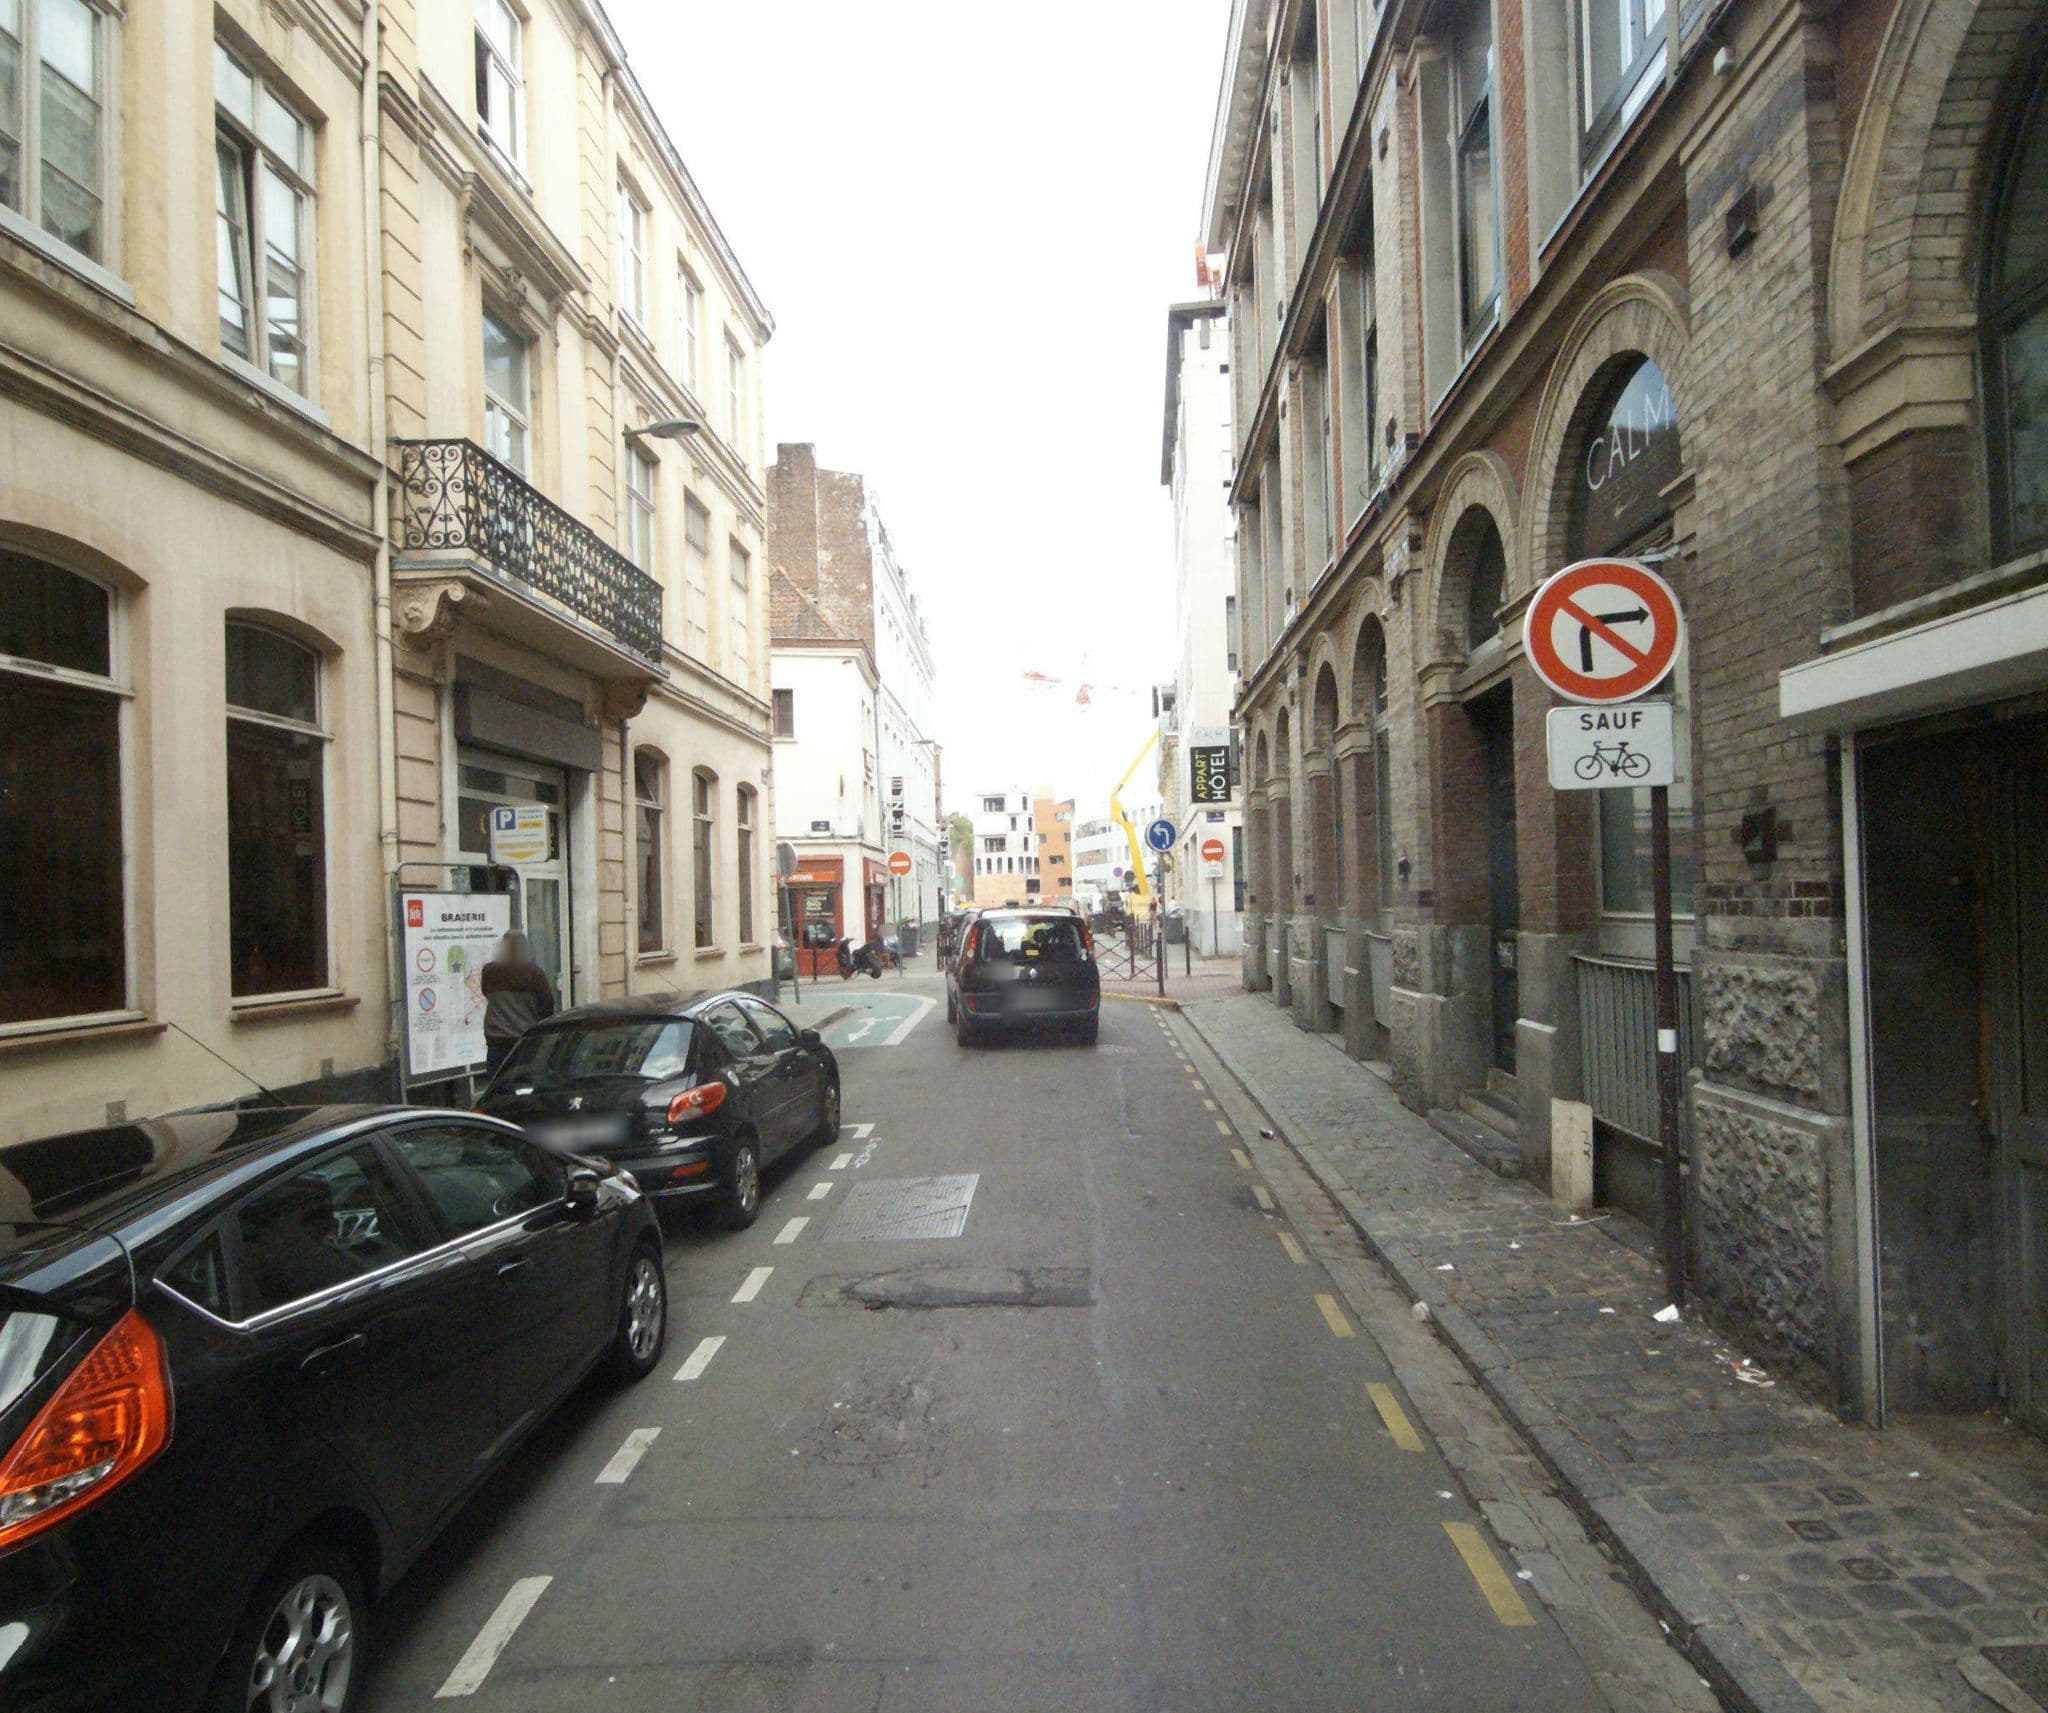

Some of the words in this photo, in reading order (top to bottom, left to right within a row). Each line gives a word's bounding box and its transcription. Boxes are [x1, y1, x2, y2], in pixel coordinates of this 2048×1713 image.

[1587, 383, 1670, 491] CALM
[1580, 711, 1643, 731] SAUF
[1209, 749, 1226, 800] HÔTEL
[441, 912, 487, 923] BRADERIE
